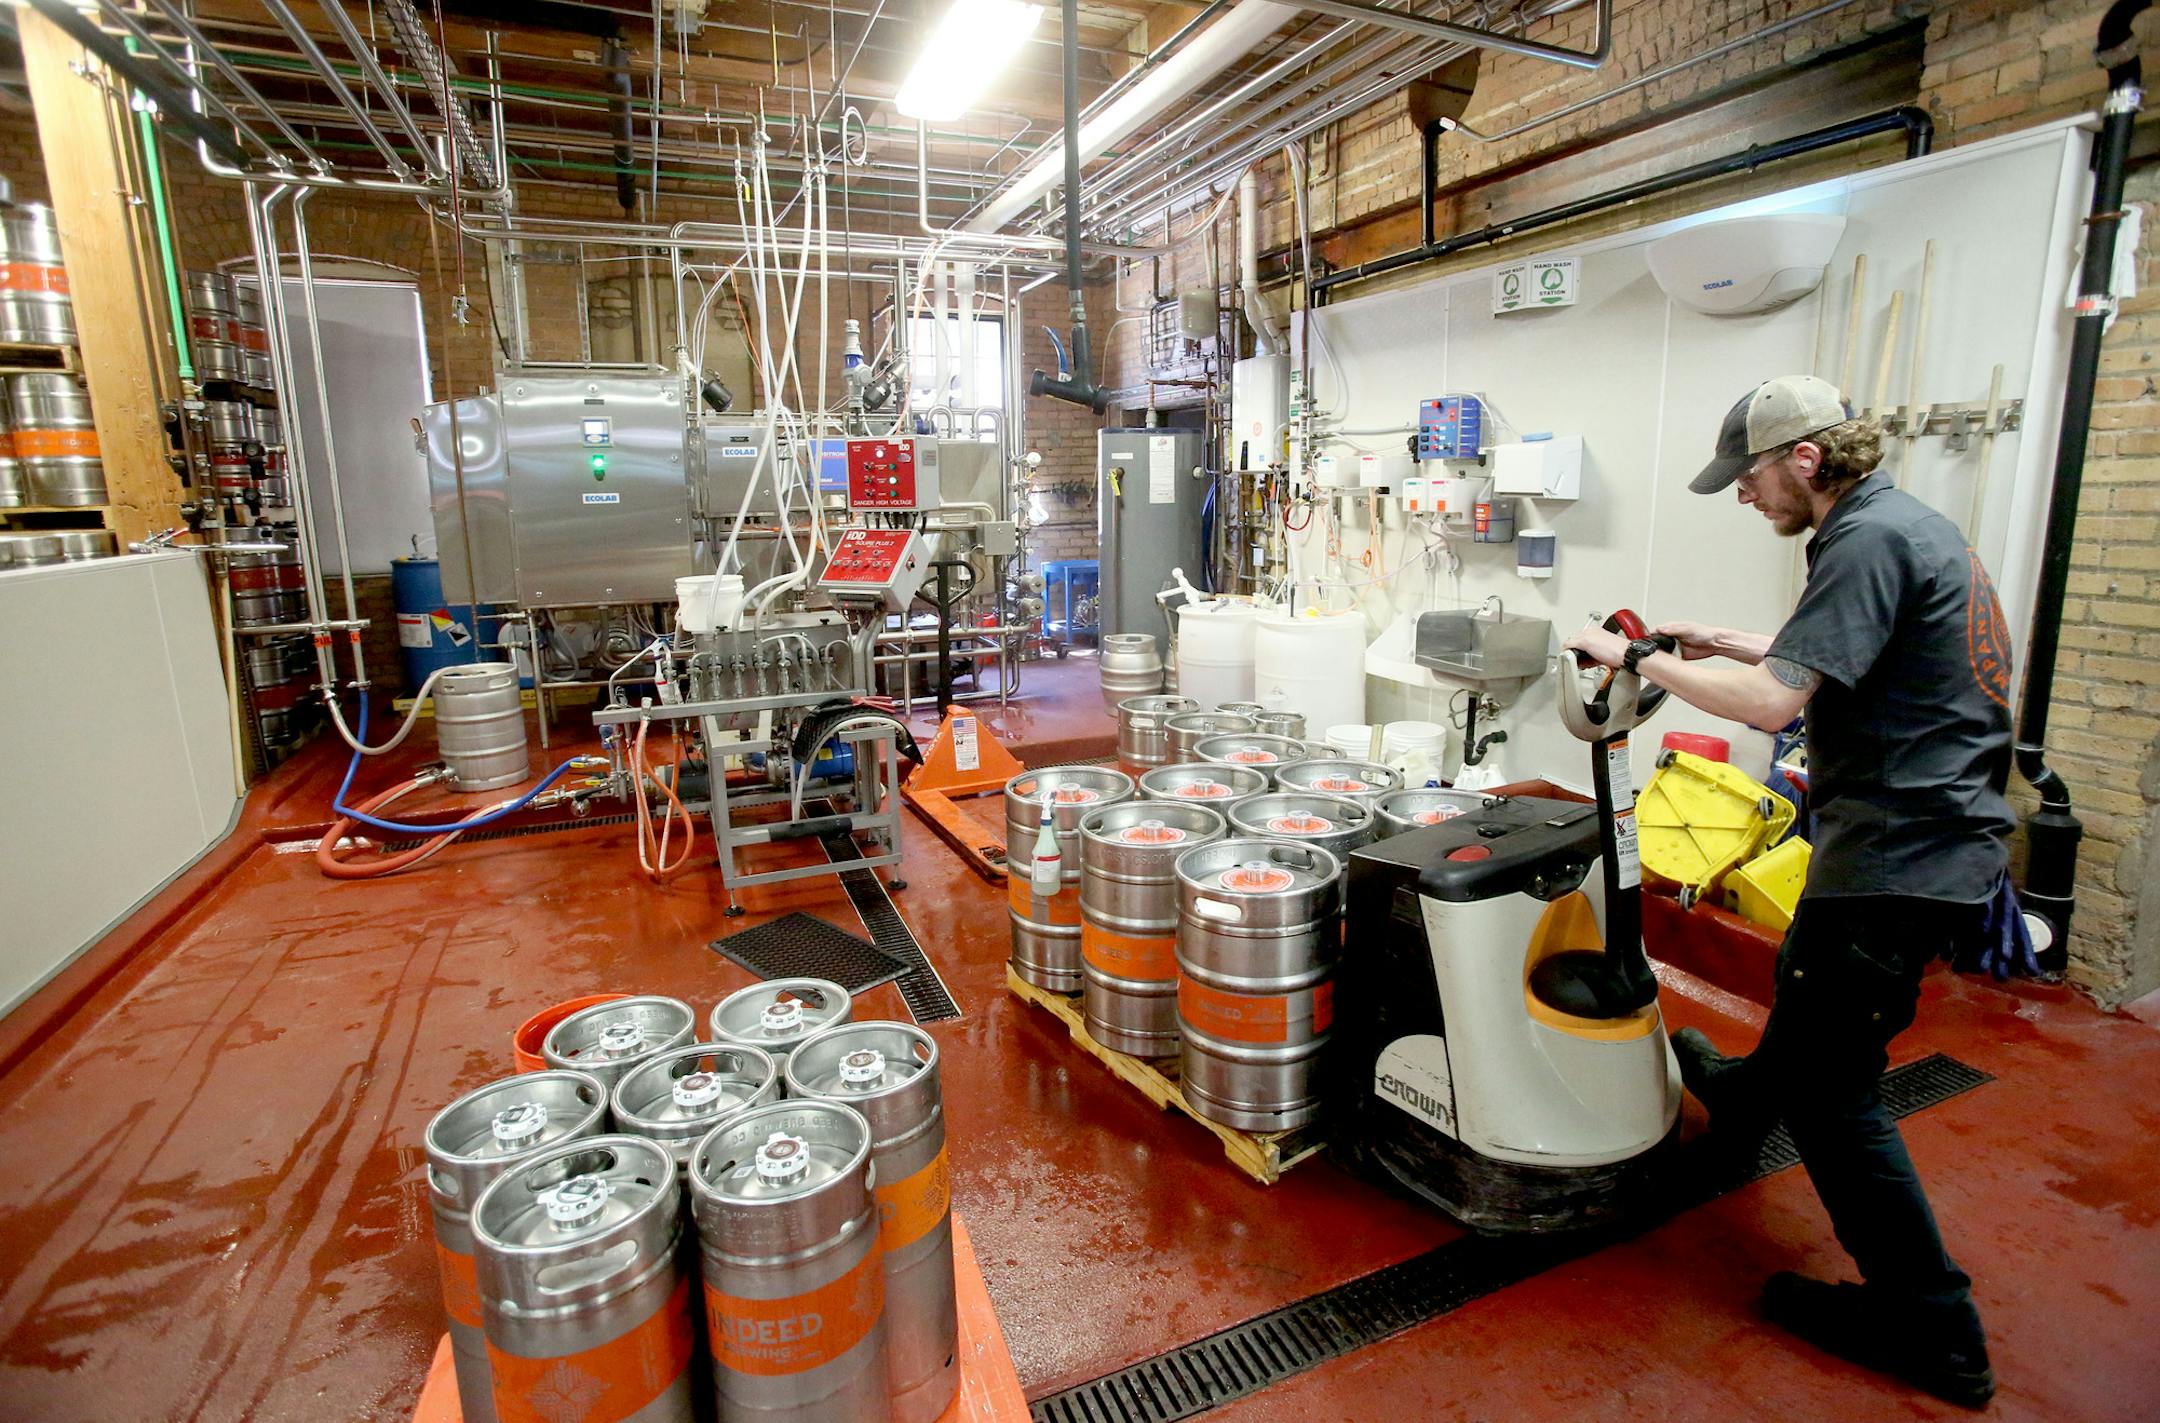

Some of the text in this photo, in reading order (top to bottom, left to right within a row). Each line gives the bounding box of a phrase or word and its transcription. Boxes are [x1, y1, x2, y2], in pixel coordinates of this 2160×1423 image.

[724, 448, 755, 456] ECOLAB
[584, 494, 618, 502] ECOLAB
[711, 1308, 823, 1345] INDEED
